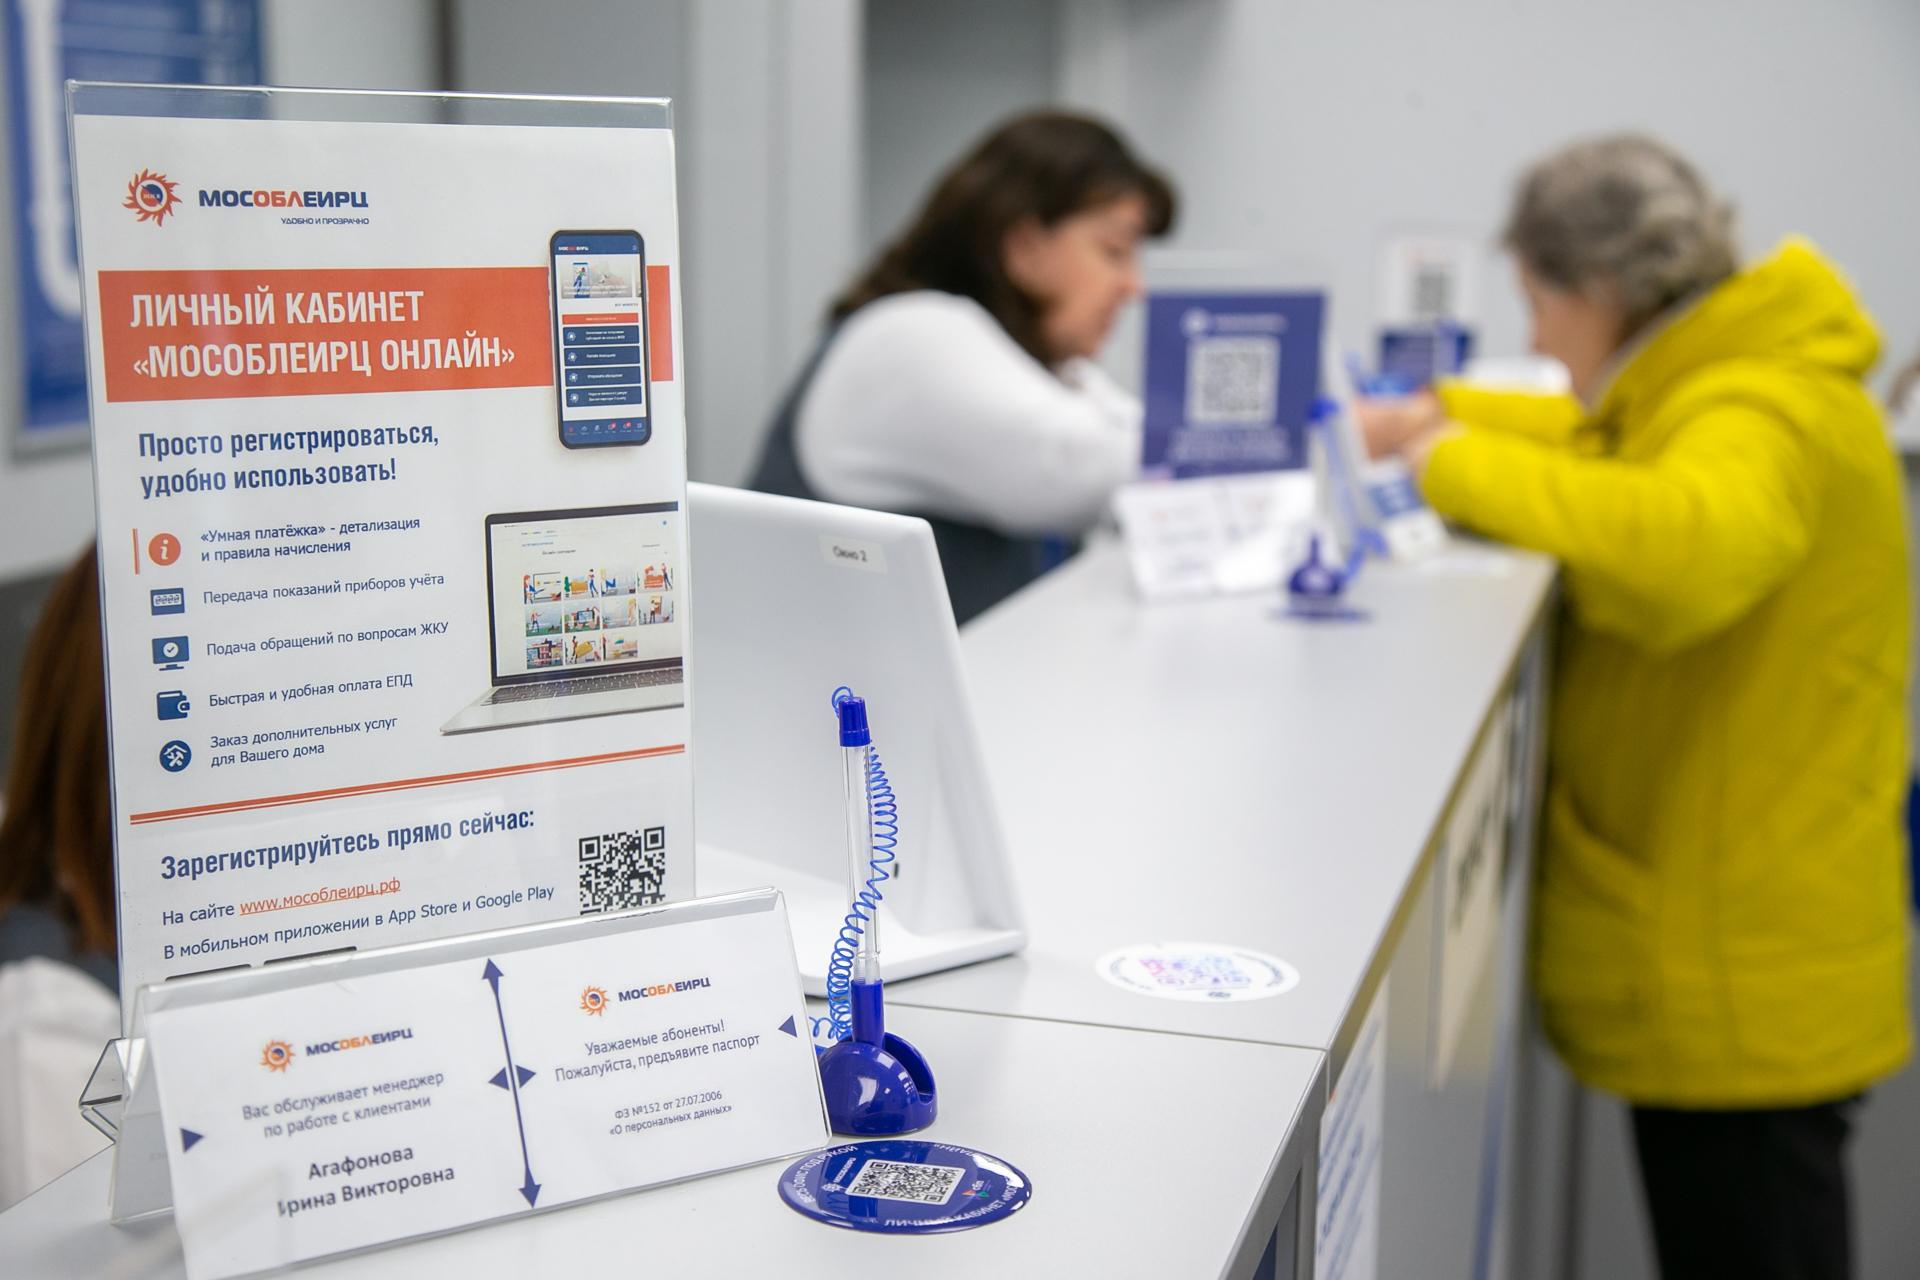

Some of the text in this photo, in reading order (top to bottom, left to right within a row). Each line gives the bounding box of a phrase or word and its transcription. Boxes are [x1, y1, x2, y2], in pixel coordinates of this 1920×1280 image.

[198, 190, 369, 208] МОСОБЛЕИРЦ
[130, 285, 423, 327] ЛИЧНЫЙ КАБИНЕТ
[133, 330, 515, 378] «МОСОБЛЕИРЦ ОНЛАЙН»
[138, 425, 438, 462] Просто регистрироваться,
[140, 458, 396, 500] удобно использовать!
[201, 529, 250, 543] «Умная
[255, 524, 325, 540] платёжка»
[339, 518, 420, 535] детализация
[201, 541, 351, 562] и правила начисления
[203, 573, 444, 604] Передача показаний приборов учёта
[207, 622, 449, 656] Подача обращений по вопросам ЖКУ
[209, 674, 413, 707] Быстрая и удобная оплата ЕПД
[210, 717, 398, 748] Заказ дополнительных услуг
[211, 744, 325, 768] для Вашего дома
[161, 810, 535, 881] Зарегистрируйтесь прямо сейчас:
[163, 877, 401, 925] На сайте www.мособлеирц.рф
[164, 886, 555, 959] В мобильном приложении в App Store и Google Play
[618, 977, 711, 1002] МОСОБЛЕИРЦ
[306, 1028, 413, 1057] МОСОБЛЕИРЦ
[585, 1019, 726, 1056] Уважаемые абоненты!
[555, 1034, 760, 1082] Пожалуйста, предъявите паспорт
[242, 1072, 444, 1120] Вас обслуживает менеджер
[615, 1091, 722, 1119] ФЗ №152 от 27.07.2006
[264, 1096, 431, 1138] по работе с клиентами
[609, 1105, 732, 1136] «О персональных данных»
[308, 1147, 413, 1180] Агафонова
[342, 1167, 455, 1202] Викторовна
